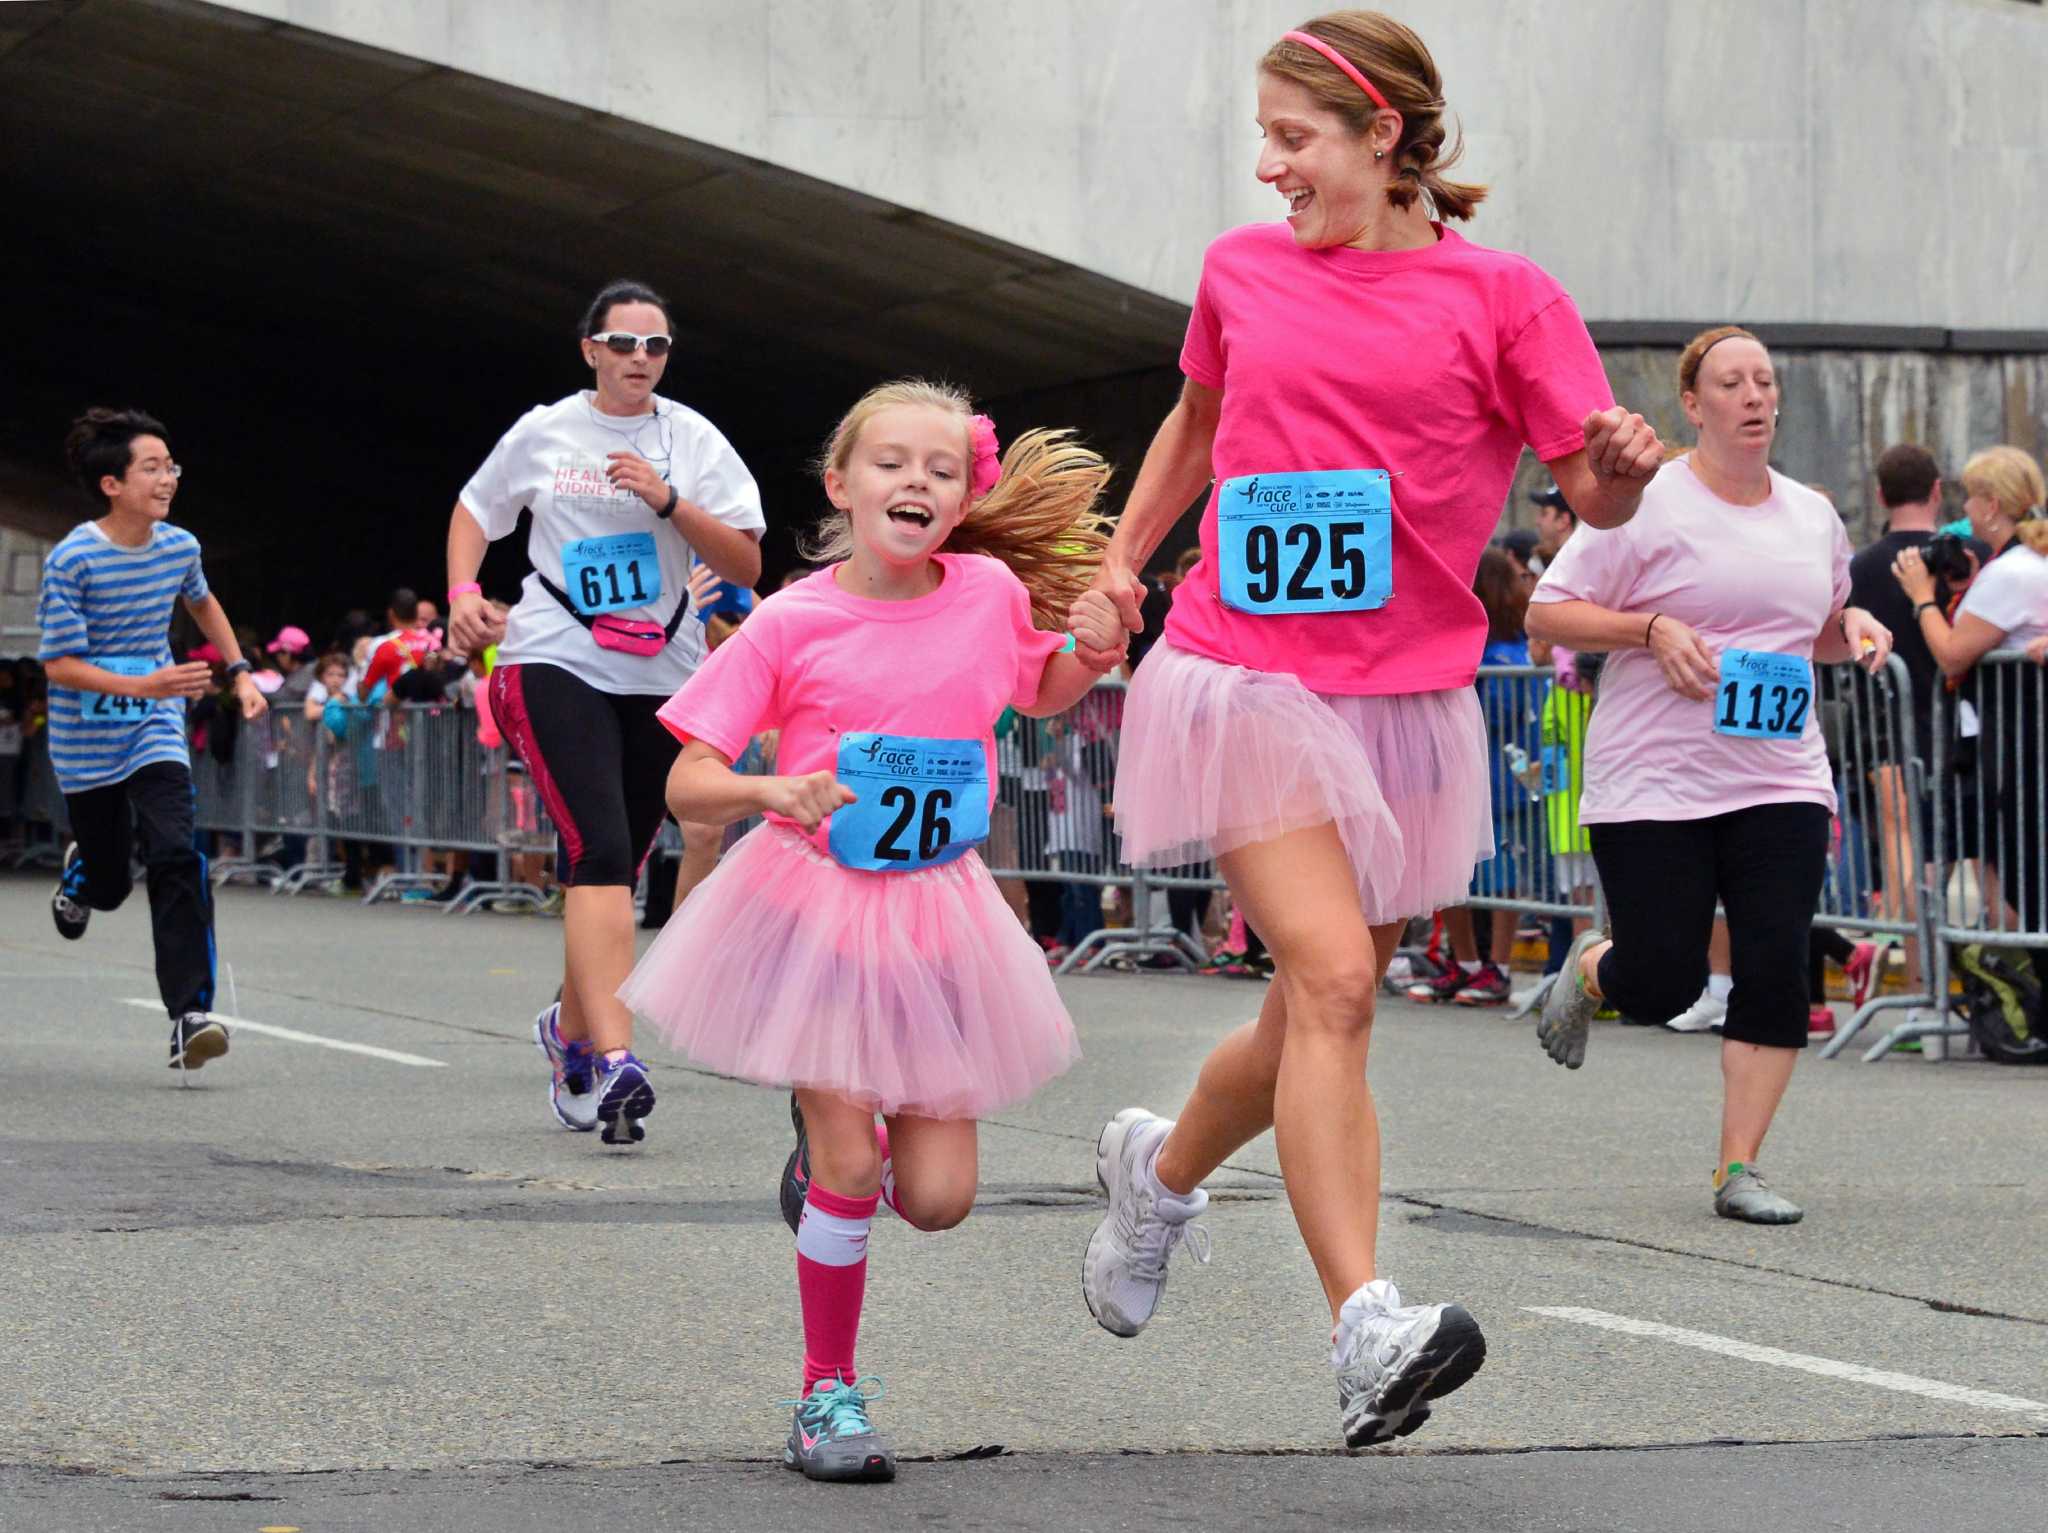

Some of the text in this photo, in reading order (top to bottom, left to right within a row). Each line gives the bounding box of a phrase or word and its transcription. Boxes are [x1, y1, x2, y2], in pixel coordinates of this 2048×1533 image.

[553, 481, 616, 496] KIDNEY
[555, 467, 611, 483] HEALT
[1256, 489, 1292, 503] race
[1245, 521, 1366, 604] 925
[580, 560, 648, 609] 611
[1719, 681, 1809, 734] 1132
[878, 751, 916, 766] race
[873, 785, 953, 862] 26
